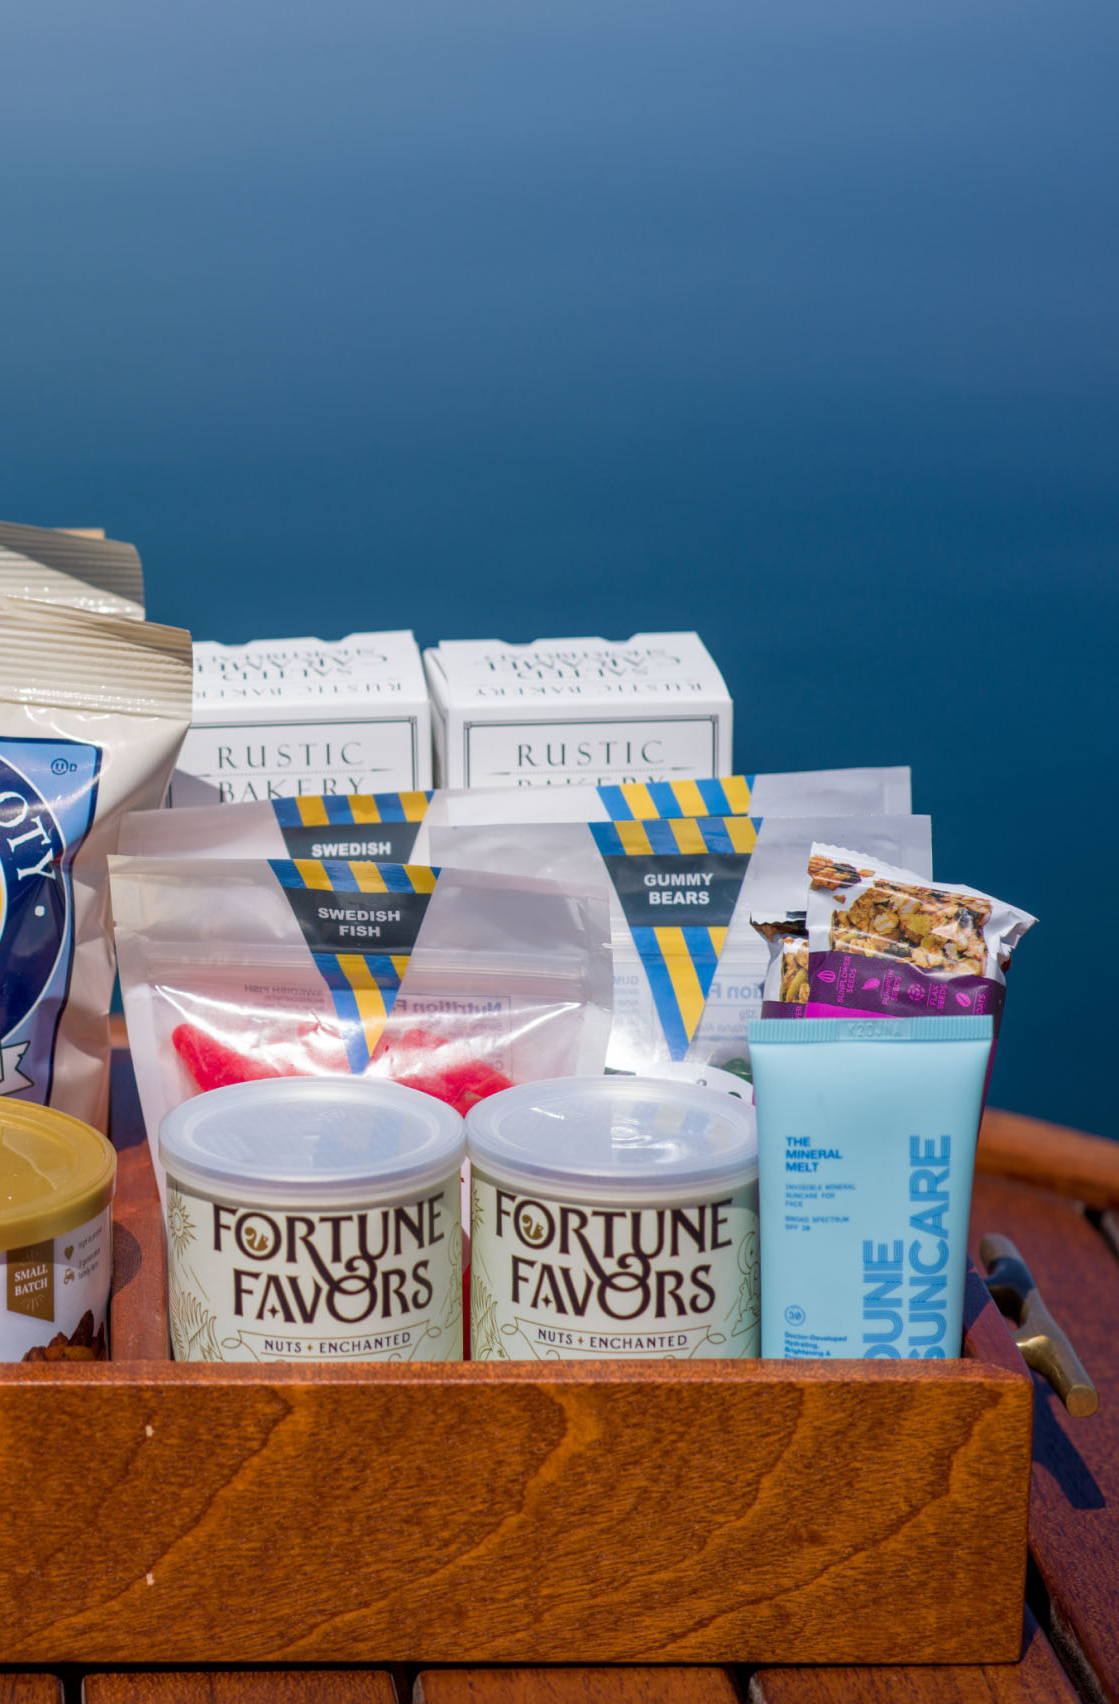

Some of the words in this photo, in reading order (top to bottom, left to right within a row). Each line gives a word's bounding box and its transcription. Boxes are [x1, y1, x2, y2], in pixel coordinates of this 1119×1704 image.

[218, 741, 365, 769] RUSTIC
[518, 740, 665, 767] RUSTIC
[311, 841, 392, 858] SWEDISH
[643, 873, 714, 887] GUMMY
[649, 891, 710, 905] BEARS
[318, 907, 401, 922] SWEDISH
[339, 925, 381, 937] FISH
[785, 1136, 811, 1147] THE
[785, 1149, 842, 1160] MINERAL
[785, 1161, 819, 1173] MELT
[212, 1191, 445, 1264] FORTUNE
[496, 1188, 734, 1260] FORTUNE
[14, 1264, 49, 1282] SMALL
[14, 1278, 48, 1296] BATCH
[234, 1258, 433, 1323] FAVORS
[511, 1257, 716, 1320] FAVORS
[264, 1339, 302, 1353] NUTS
[319, 1331, 411, 1354] ENCHANTED
[537, 1327, 574, 1345] NUTS
[589, 1334, 688, 1350] ENCHANTED
